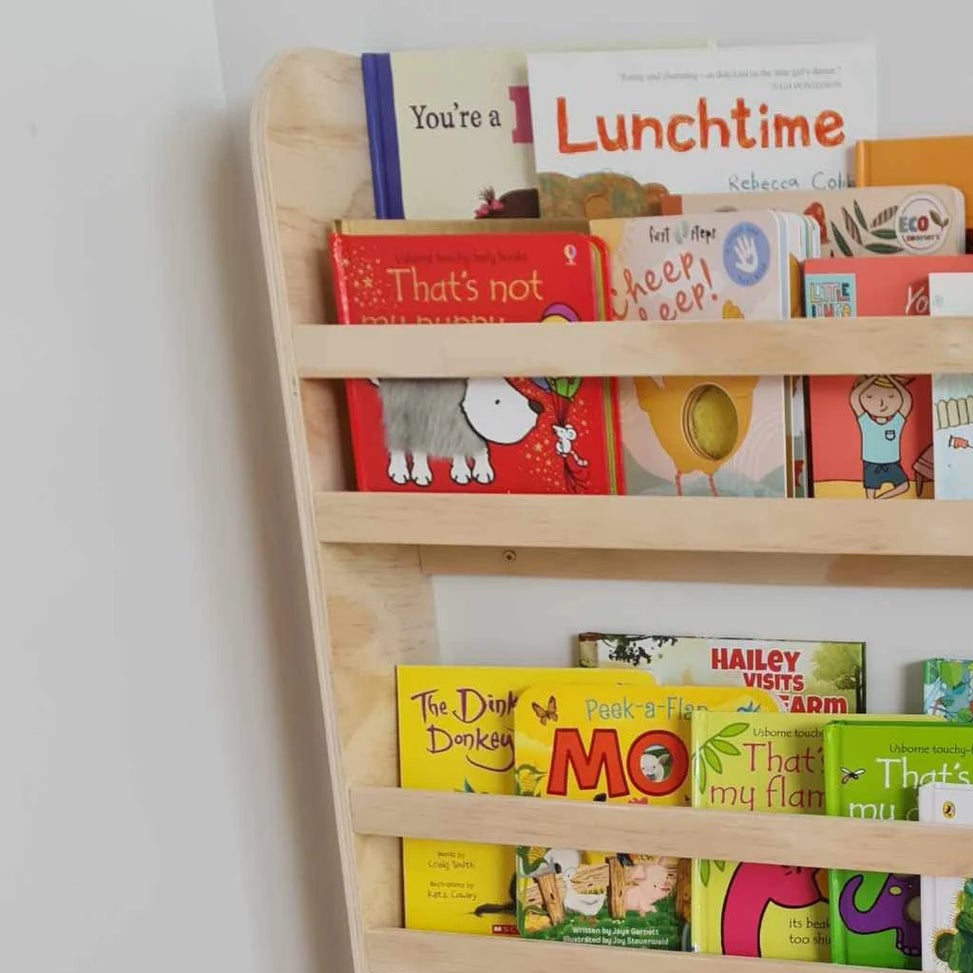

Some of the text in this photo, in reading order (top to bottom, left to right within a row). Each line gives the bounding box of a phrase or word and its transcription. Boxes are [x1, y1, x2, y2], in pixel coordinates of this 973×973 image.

[409, 102, 502, 129] You're a
[556, 97, 846, 153] Lunchtime
[728, 171, 800, 191] Rebecca
[899, 215, 930, 233] ECO
[386, 266, 544, 303] That's not
[743, 672, 805, 692] VISITS
[410, 688, 448, 723] The
[752, 727, 792, 738] Usborne
[426, 724, 515, 772] Donkey
[889, 743, 930, 755] Usborne
[546, 727, 690, 799] MO
[875, 757, 970, 788] That's
[710, 785, 755, 811] my
[601, 927, 612, 937] by
[788, 917, 803, 929] its
[601, 936, 612, 946] by
[788, 934, 810, 945] too
